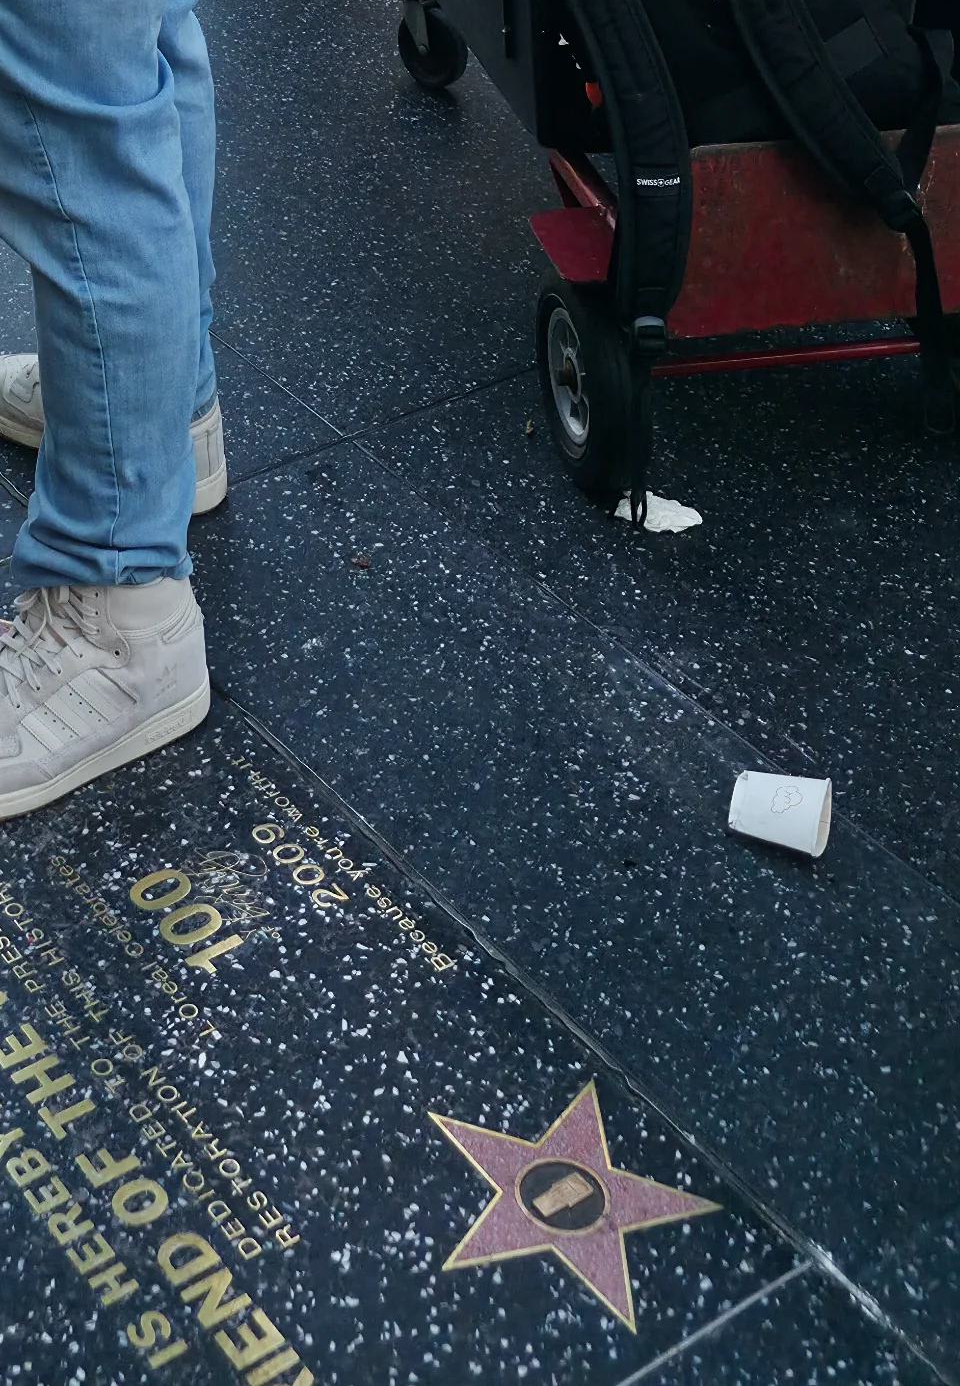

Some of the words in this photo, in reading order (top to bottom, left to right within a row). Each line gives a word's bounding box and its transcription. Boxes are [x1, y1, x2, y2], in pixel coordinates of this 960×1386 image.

[637, 178, 657, 186] SWISS
[250, 771, 303, 823] worth
[252, 823, 349, 908] 2009
[130, 869, 244, 974] 100
[366, 885, 456, 972] Because
[44, 1000, 90, 1051] THE
[61, 970, 109, 1023] THIS
[109, 1029, 143, 1061] OF
[91, 1058, 126, 1094] TO
[129, 1104, 262, 1260] DEDICATED
[141, 1065, 301, 1248] RESTORATION
[75, 1148, 169, 1226] OF
[126, 1311, 188, 1370] IS
